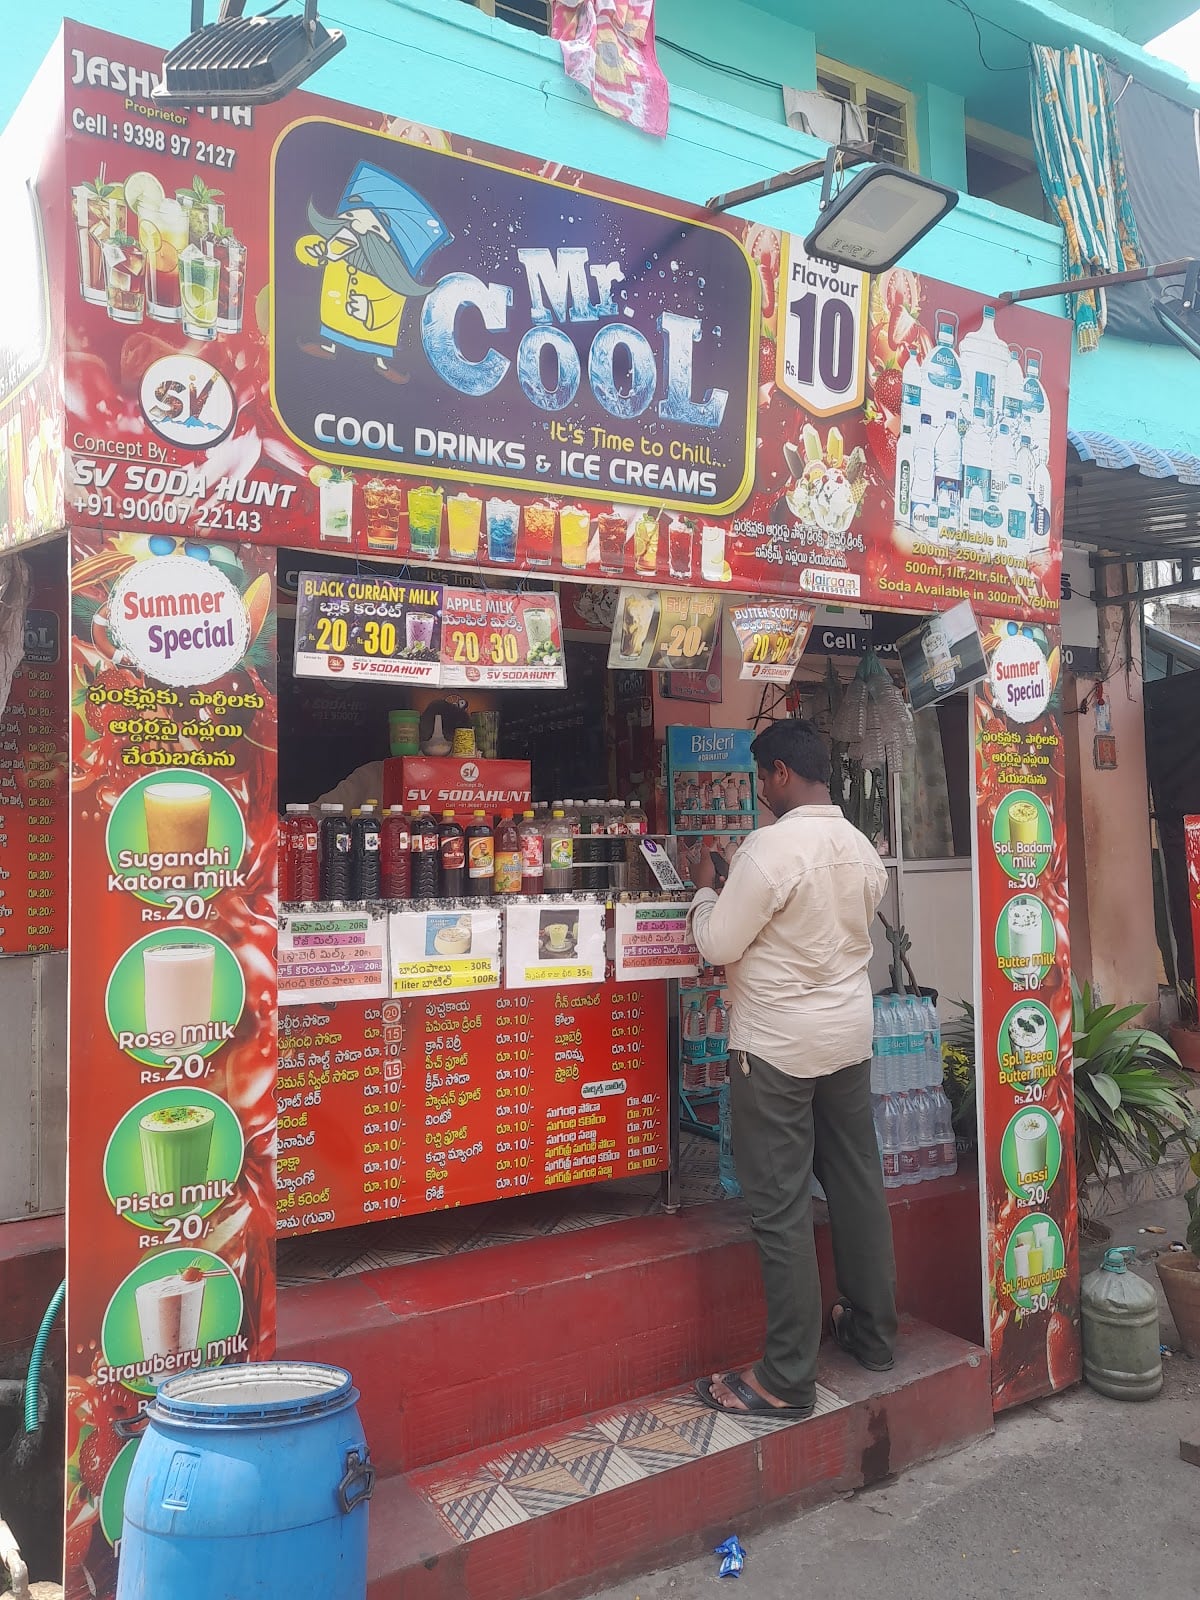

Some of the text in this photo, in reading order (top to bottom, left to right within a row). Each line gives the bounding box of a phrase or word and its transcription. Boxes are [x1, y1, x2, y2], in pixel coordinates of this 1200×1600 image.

[124, 99, 187, 125] Proprietor
[72, 107, 236, 168] Cell 9398 97 2127
[791, 263, 859, 298] Flavour
[785, 292, 855, 394] Rs. 10
[73, 432, 167, 463] Concept By
[549, 419, 585, 444] It's
[588, 426, 635, 453] Time
[639, 436, 663, 457] to
[313, 412, 718, 498] COOL DRINKS & ICE CREAMS
[73, 459, 297, 508] SV SODA HUNT
[74, 493, 262, 532] +91 90007 22143
[940, 526, 1007, 548] Available in
[912, 543, 951, 559] 200ml,
[305, 580, 440, 606] BLACK CURRANT MILK
[878, 577, 1059, 610] Soda Available in 300ml, 750ml
[123, 591, 225, 621] Summer
[446, 597, 514, 615] APPLE MILK
[734, 607, 798, 620] BUTTER SCOTCH
[148, 618, 235, 660] Special
[316, 618, 396, 655] 20 30
[452, 632, 479, 662] 20
[489, 633, 518, 663] 30
[753, 634, 769, 662] 20
[823, 631, 856, 650] Cell
[352, 661, 369, 674] SV
[486, 671, 502, 680] SV
[996, 660, 1041, 681] Summer
[1007, 679, 1045, 706] Special
[691, 733, 735, 754] Bisleri
[407, 789, 432, 801] SV
[118, 847, 229, 872] Sugandhi
[994, 841, 1053, 854] Spl. Badam
[107, 873, 186, 892] Katora
[997, 957, 1030, 970] Butter
[401, 980, 420, 990] liter
[118, 1031, 175, 1050] Rose
[1002, 1049, 1053, 1067] Spl. Zeera
[999, 1069, 1031, 1085] Butter
[1017, 1167, 1048, 1186] Lassi
[115, 1191, 174, 1216] Pista
[1001, 1281, 1016, 1296] Spl.
[1016, 1272, 1051, 1291] Flavoured
[97, 1348, 202, 1385] Strawberry
